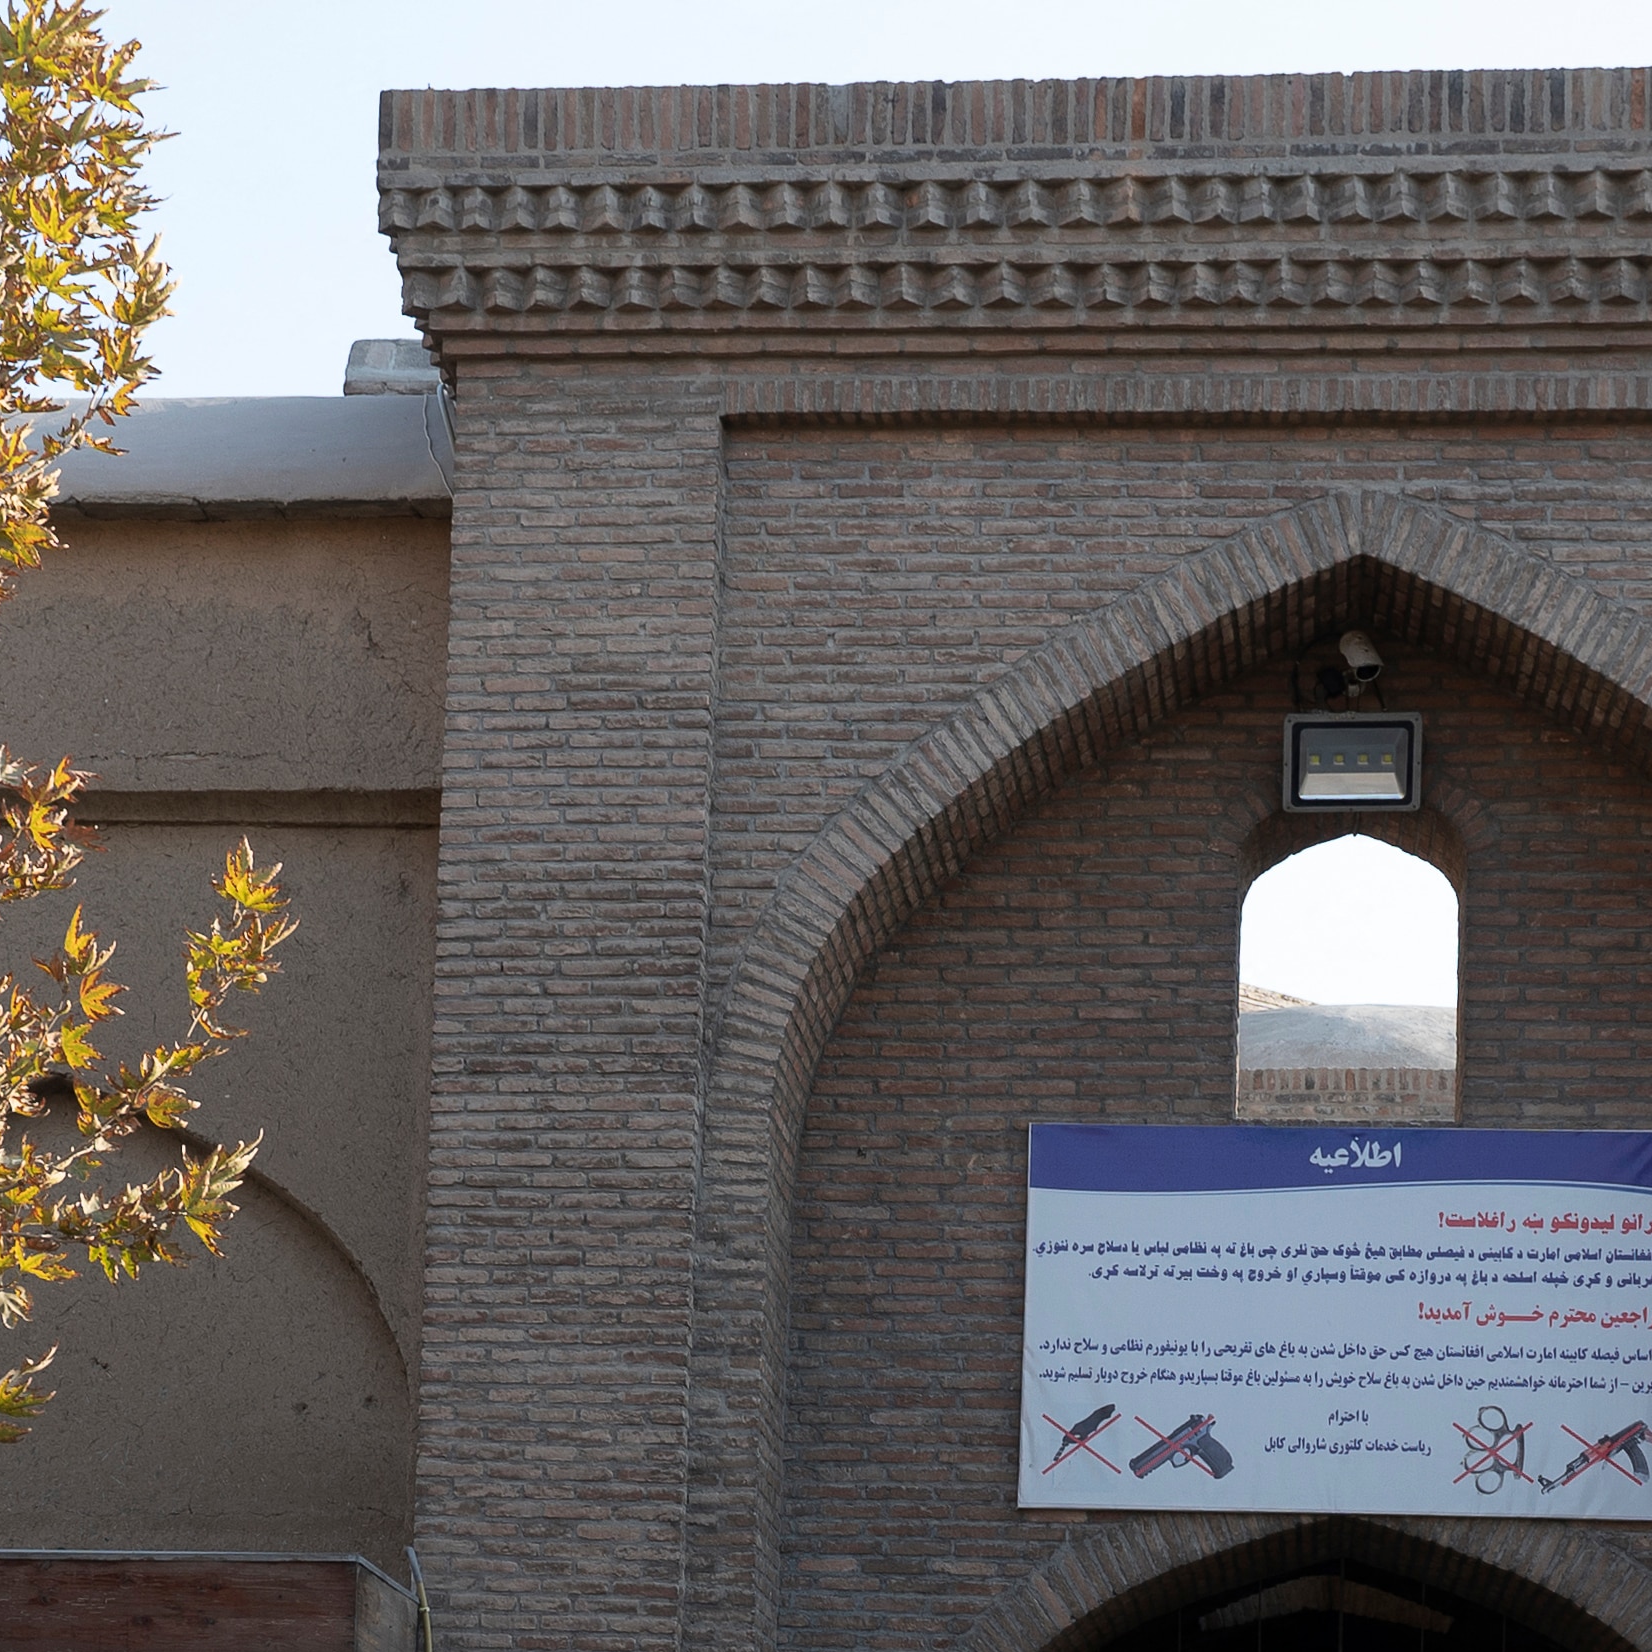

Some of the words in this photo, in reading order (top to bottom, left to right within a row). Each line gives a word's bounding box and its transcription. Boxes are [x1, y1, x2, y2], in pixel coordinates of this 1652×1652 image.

[1309, 1136, 1402, 1175] اطلاعیه
[1438, 1211, 1517, 1233] راغلاست!
[1550, 1212, 1616, 1234] لیدونکو
[1072, 1242, 1095, 1255] سره
[1131, 1241, 1140, 1256] یا
[1144, 1241, 1170, 1256] لباس
[1172, 1241, 1208, 1256] نظامی
[1211, 1245, 1222, 1259] په
[1225, 1242, 1237, 1254] ته
[1239, 1242, 1256, 1258] باغ
[1310, 1246, 1330, 1258] حق
[1389, 1245, 1424, 1261] مطابق
[1426, 1246, 1466, 1261] فیصلی
[1468, 1249, 1476, 1258] د
[1517, 1250, 1524, 1259] د
[1527, 1247, 1561, 1263] امارت
[1564, 1248, 1603, 1263] اسلامی
[1123, 1264, 1160, 1280] ترلاسه
[1163, 1265, 1194, 1281] بیرته
[1196, 1265, 1229, 1281] وخت
[1232, 1269, 1244, 1283] په
[1286, 1267, 1299, 1282] او
[1409, 1269, 1452, 1285] دروازه
[1456, 1273, 1468, 1287] په
[1471, 1270, 1489, 1286] باغ
[1491, 1273, 1499, 1282] د
[1503, 1271, 1538, 1283] اسلحه
[1541, 1271, 1570, 1288] خپله
[1605, 1275, 1614, 1288] و
[1418, 1301, 1473, 1324] آمدید!
[1548, 1309, 1597, 1328] محترم
[1039, 1338, 1072, 1354] ندارد.
[1074, 1338, 1100, 1354] سلاح
[1101, 1344, 1109, 1355] و
[1110, 1339, 1144, 1355] نظامی
[1145, 1340, 1189, 1356] یونیفورم
[1191, 1340, 1199, 1356] با
[1201, 1341, 1212, 1357] را
[1213, 1341, 1253, 1358] تفریحی
[1254, 1342, 1277, 1358] های
[1279, 1341, 1296, 1358] باغ
[1297, 1345, 1309, 1358] به
[1310, 1343, 1336, 1359] شدن
[1338, 1343, 1367, 1359] داخل
[1369, 1346, 1388, 1360] حق
[1390, 1344, 1412, 1360] کس
[1436, 1345, 1485, 1361] افغانستان
[1486, 1346, 1524, 1362] اسلامی
[1414, 1348, 1435, 1361] هیچ
[1526, 1347, 1558, 1363] امارت
[1591, 1347, 1621, 1364] فیصله
[1622, 1349, 1652, 1364] اساس
[1039, 1366, 1067, 1382] شوید.
[1068, 1366, 1094, 1382] تسلیم
[1094, 1367, 1119, 1383] دوبار
[1150, 1368, 1177, 1384] هنگام
[1245, 1368, 1261, 1386] باغ
[1303, 1374, 1313, 1387] به
[1314, 1371, 1324, 1388] را
[1325, 1372, 1357, 1388] خویش
[1358, 1371, 1382, 1388] سلاح
[1384, 1371, 1400, 1389] باغ
[1412, 1374, 1436, 1389] شدن
[1438, 1373, 1464, 1390] داخل
[1401, 1376, 1411, 1389] به
[1465, 1378, 1487, 1390] حین
[1488, 1375, 1547, 1392] خواهشمندیم
[1589, 1376, 1607, 1389] شما
[1608, 1377, 1619, 1393] از
[1328, 1409, 1361, 1426] احترام
[1362, 1410, 1370, 1426] با
[1264, 1437, 1287, 1452] کابل
[1287, 1437, 1328, 1454] شاروالی
[1329, 1438, 1364, 1455] کلتوری
[1365, 1439, 1400, 1451] خدمات
[1401, 1440, 1432, 1456] ریاست
